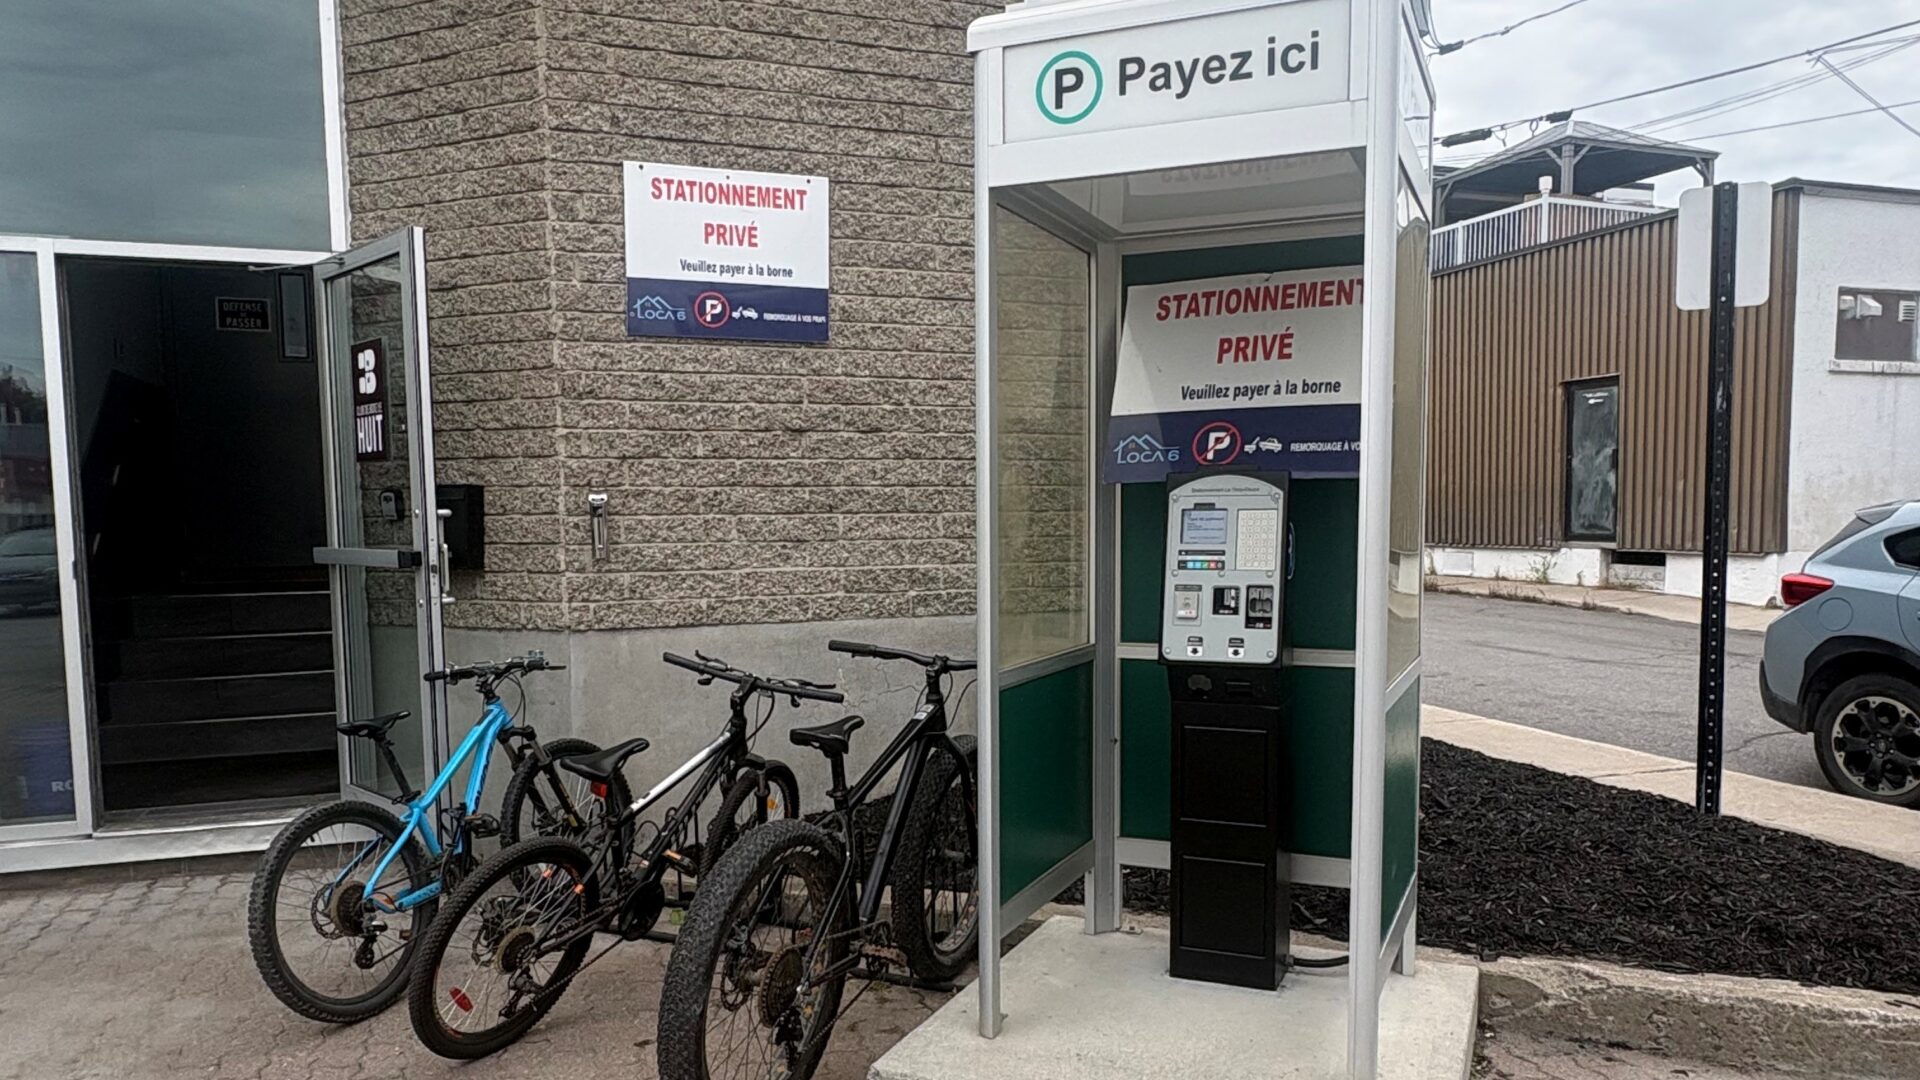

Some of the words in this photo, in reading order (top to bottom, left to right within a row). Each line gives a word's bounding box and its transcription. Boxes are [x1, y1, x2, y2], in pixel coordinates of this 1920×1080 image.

[1118, 49, 1253, 99] Payez
[1267, 30, 1319, 76] ici
[1053, 66, 1084, 110] P
[651, 177, 807, 210] STATIONNEMENT
[704, 221, 758, 247] PRIVÉ
[680, 258, 717, 273] Veuillez
[719, 264, 745, 277] payer
[748, 263, 754, 275] à
[756, 264, 764, 275] la
[767, 265, 793, 277] borne
[226, 317, 262, 328] PASSER
[1217, 326, 1294, 364] PRIVÉ
[1181, 383, 1230, 400] Veuillez
[1233, 383, 1270, 401] payer
[1273, 379, 1281, 395] à
[1285, 379, 1297, 394] la
[1301, 378, 1341, 394] borne
[356, 414, 383, 454] HUIT
[1290, 441, 1342, 452] REMORQUAGE
[1167, 450, 1179, 461] 6
